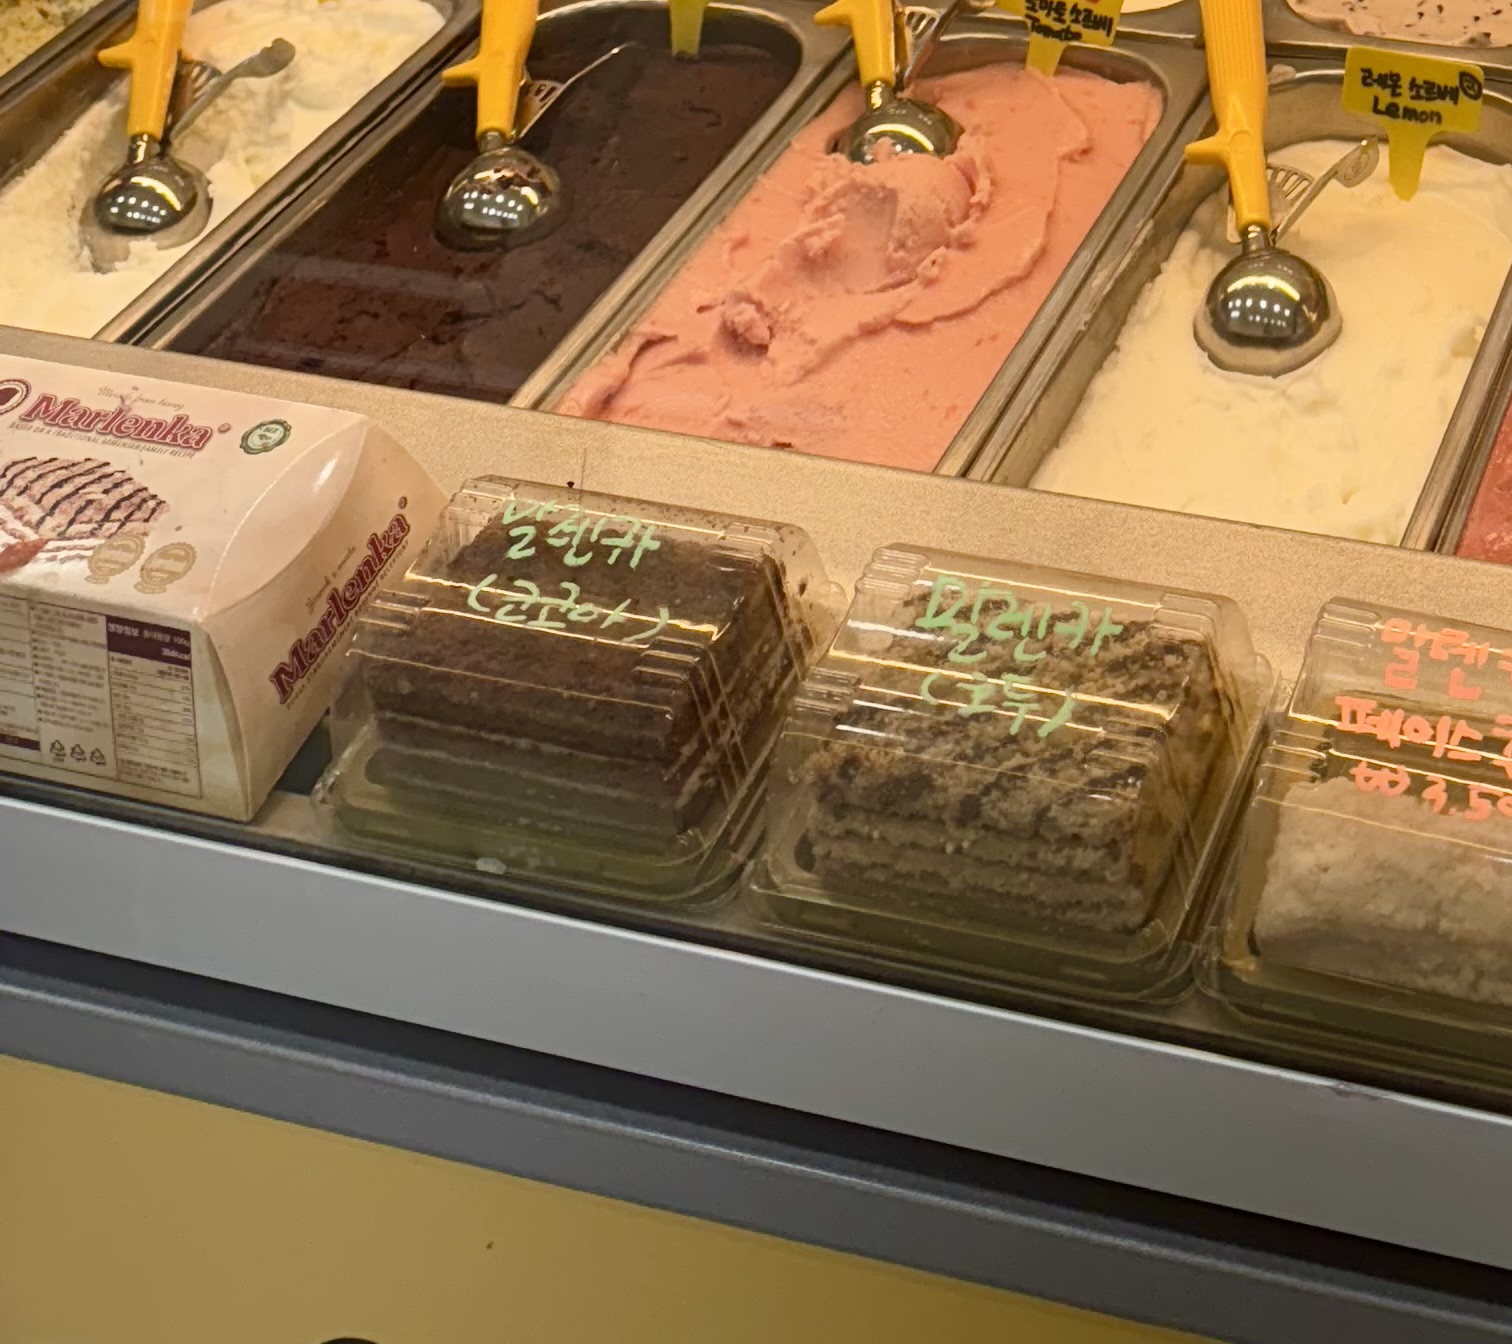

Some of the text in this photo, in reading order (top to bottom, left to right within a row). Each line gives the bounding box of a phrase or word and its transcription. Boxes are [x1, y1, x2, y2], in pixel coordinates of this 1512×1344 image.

[1070, 2, 1115, 39] 소르베
[1360, 66, 1460, 106] 레몬 소르베
[18, 391, 214, 452] Marlenka
[268, 513, 411, 705] Marlenka
[915, 574, 1124, 663] 말렌카
